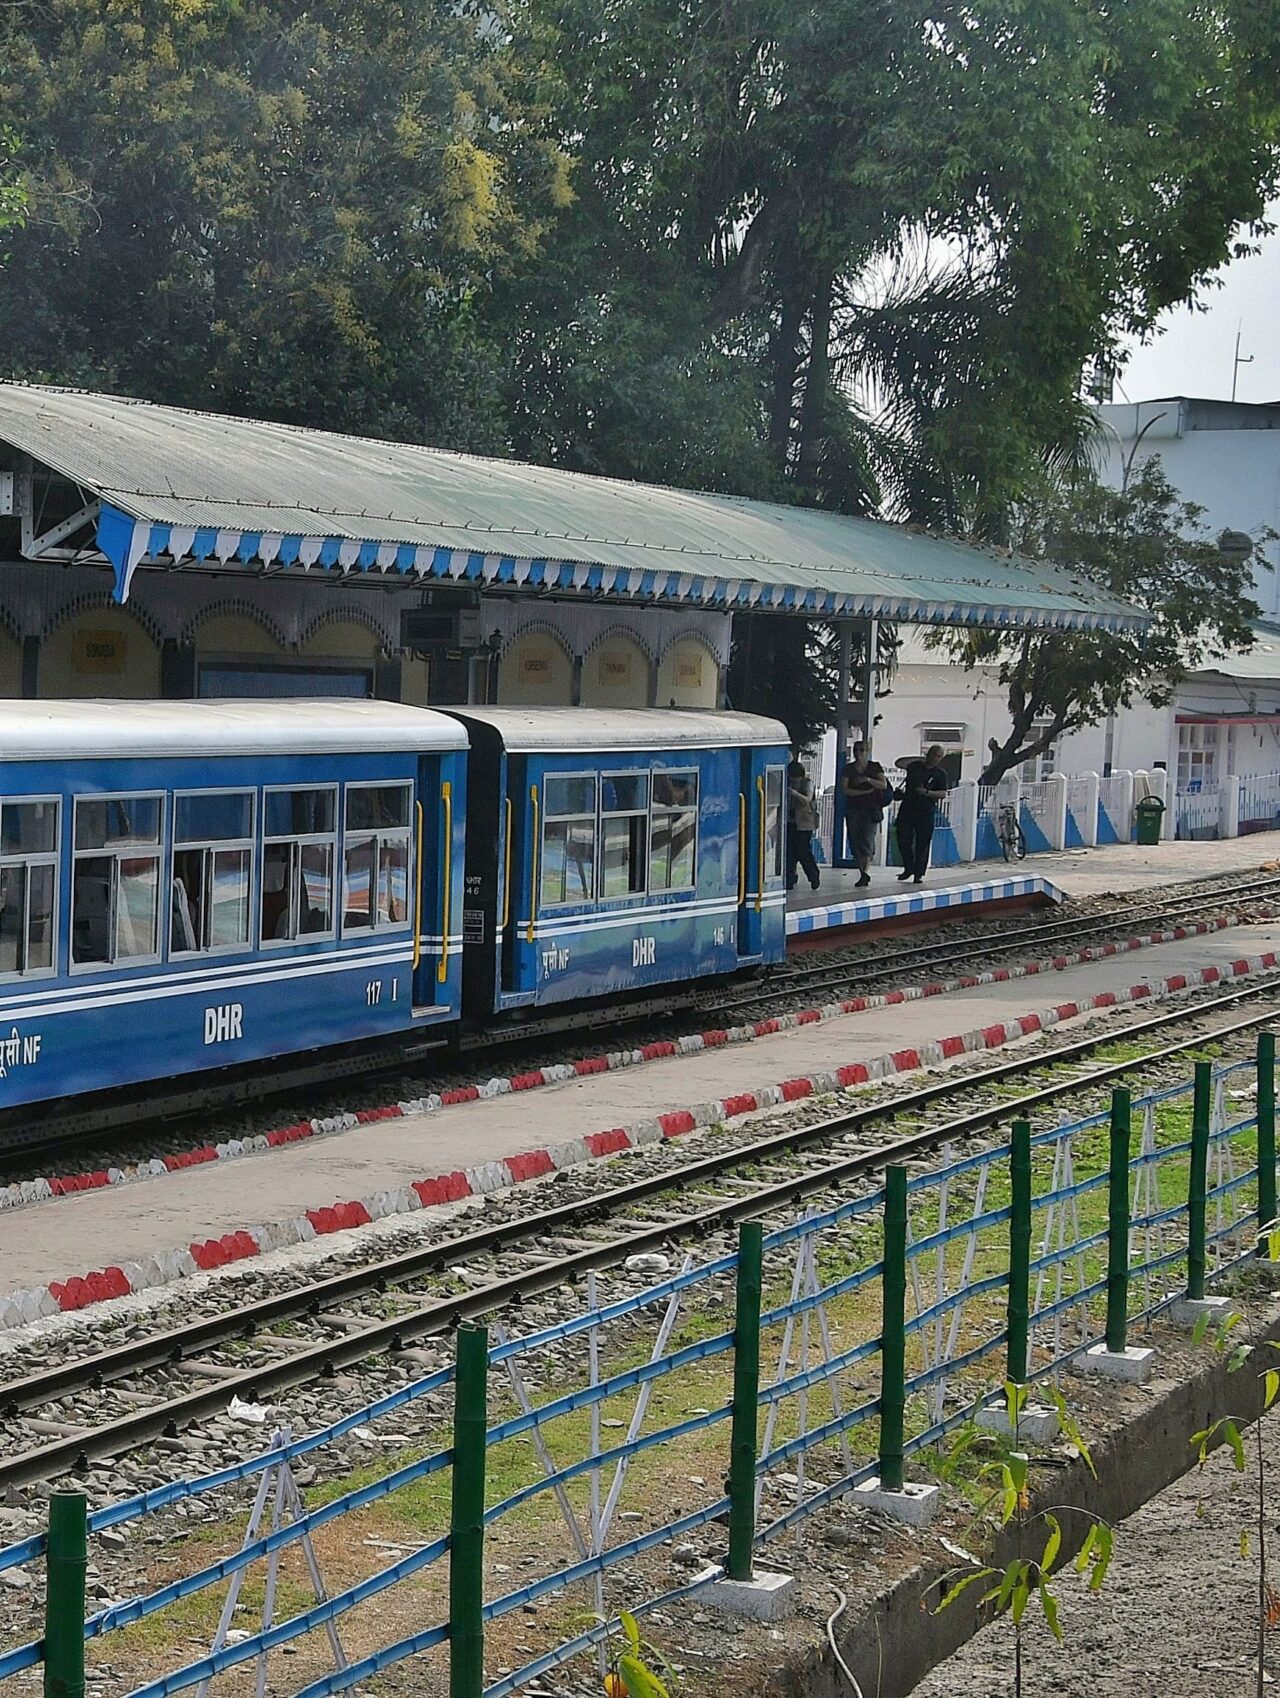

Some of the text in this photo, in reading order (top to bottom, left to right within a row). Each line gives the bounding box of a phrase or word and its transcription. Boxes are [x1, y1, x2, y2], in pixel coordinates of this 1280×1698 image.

[558, 948, 570, 970] NF
[632, 937, 656, 967] DHR
[366, 981, 381, 1005] 117
[204, 1003, 243, 1045] DHR
[23, 1035, 42, 1065] NF
